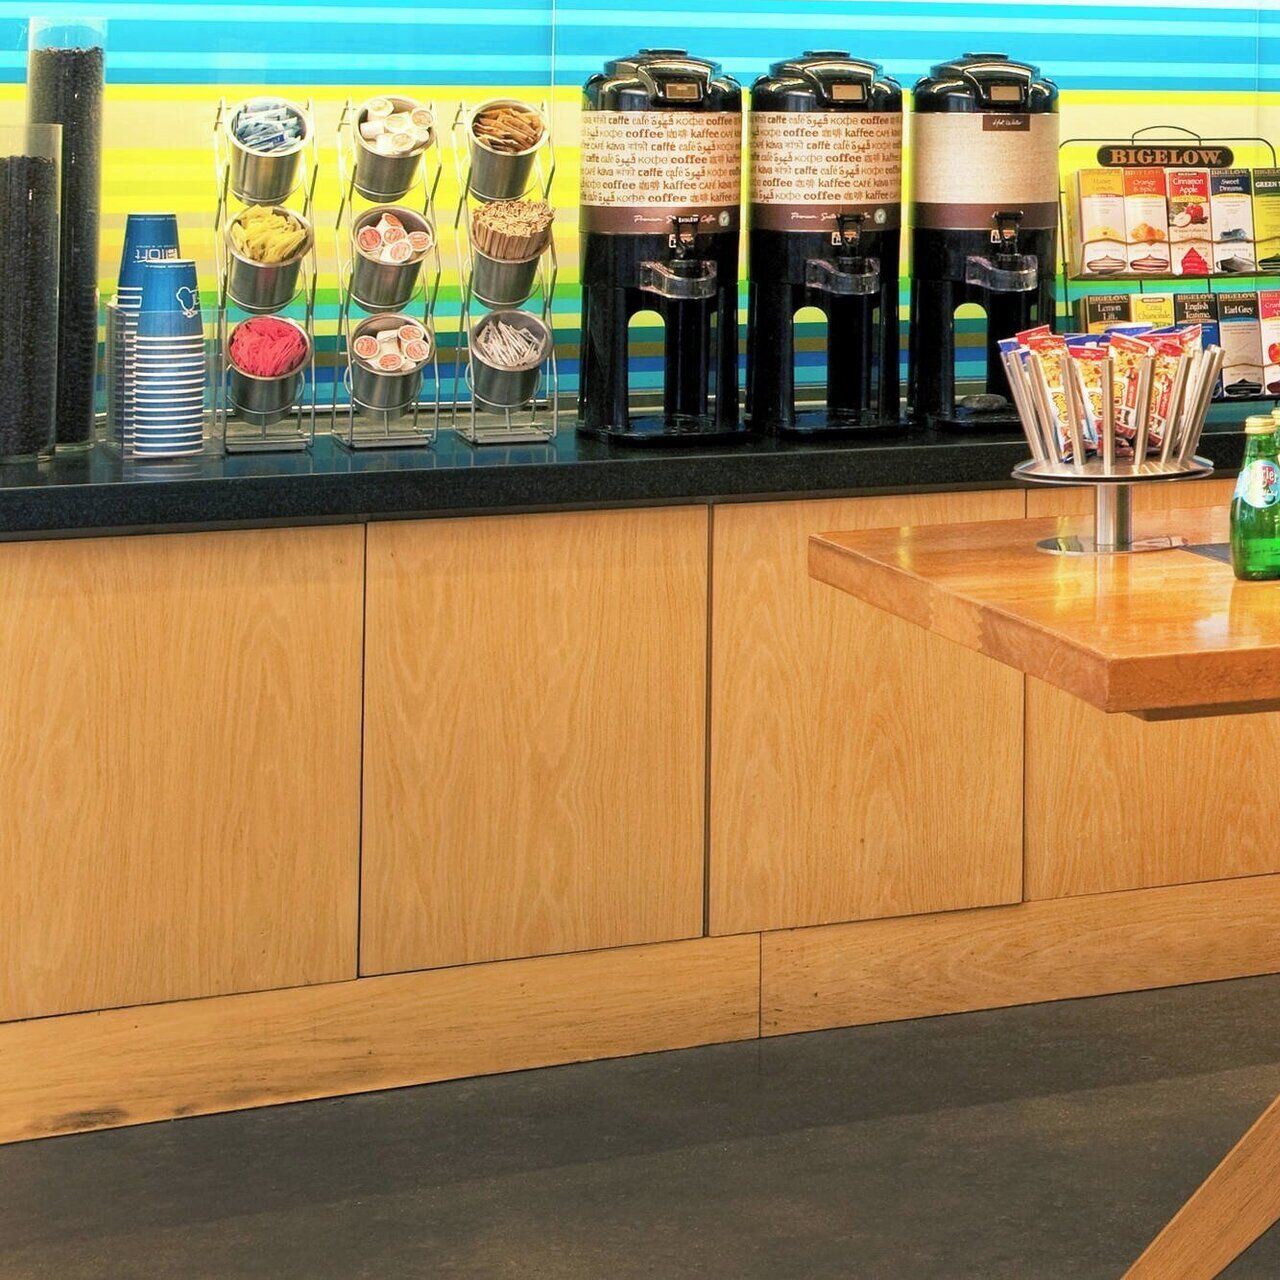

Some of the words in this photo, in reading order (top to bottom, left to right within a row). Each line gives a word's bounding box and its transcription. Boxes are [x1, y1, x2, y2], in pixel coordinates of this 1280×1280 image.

[625, 128, 665, 139] coffee
[825, 153, 863, 163] coffee
[1109, 148, 1220, 165] BIGELOW
[1255, 180, 1277, 189] GREEN
